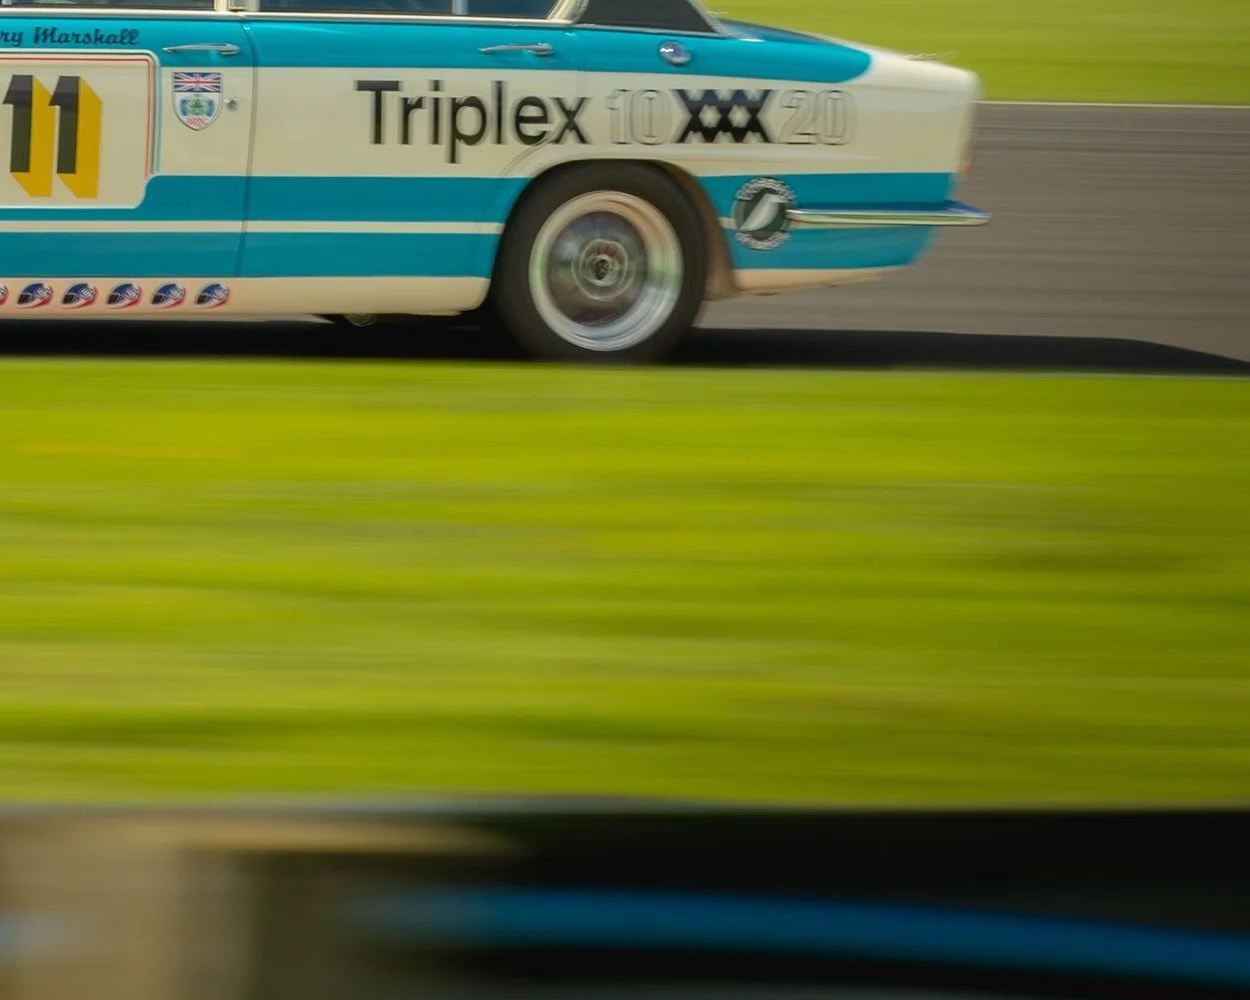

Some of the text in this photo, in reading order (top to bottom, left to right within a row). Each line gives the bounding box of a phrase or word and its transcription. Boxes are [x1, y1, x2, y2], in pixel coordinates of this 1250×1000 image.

[33, 27, 139, 46] Marshall
[2, 74, 103, 199] 11
[355, 79, 592, 164] Triplex
